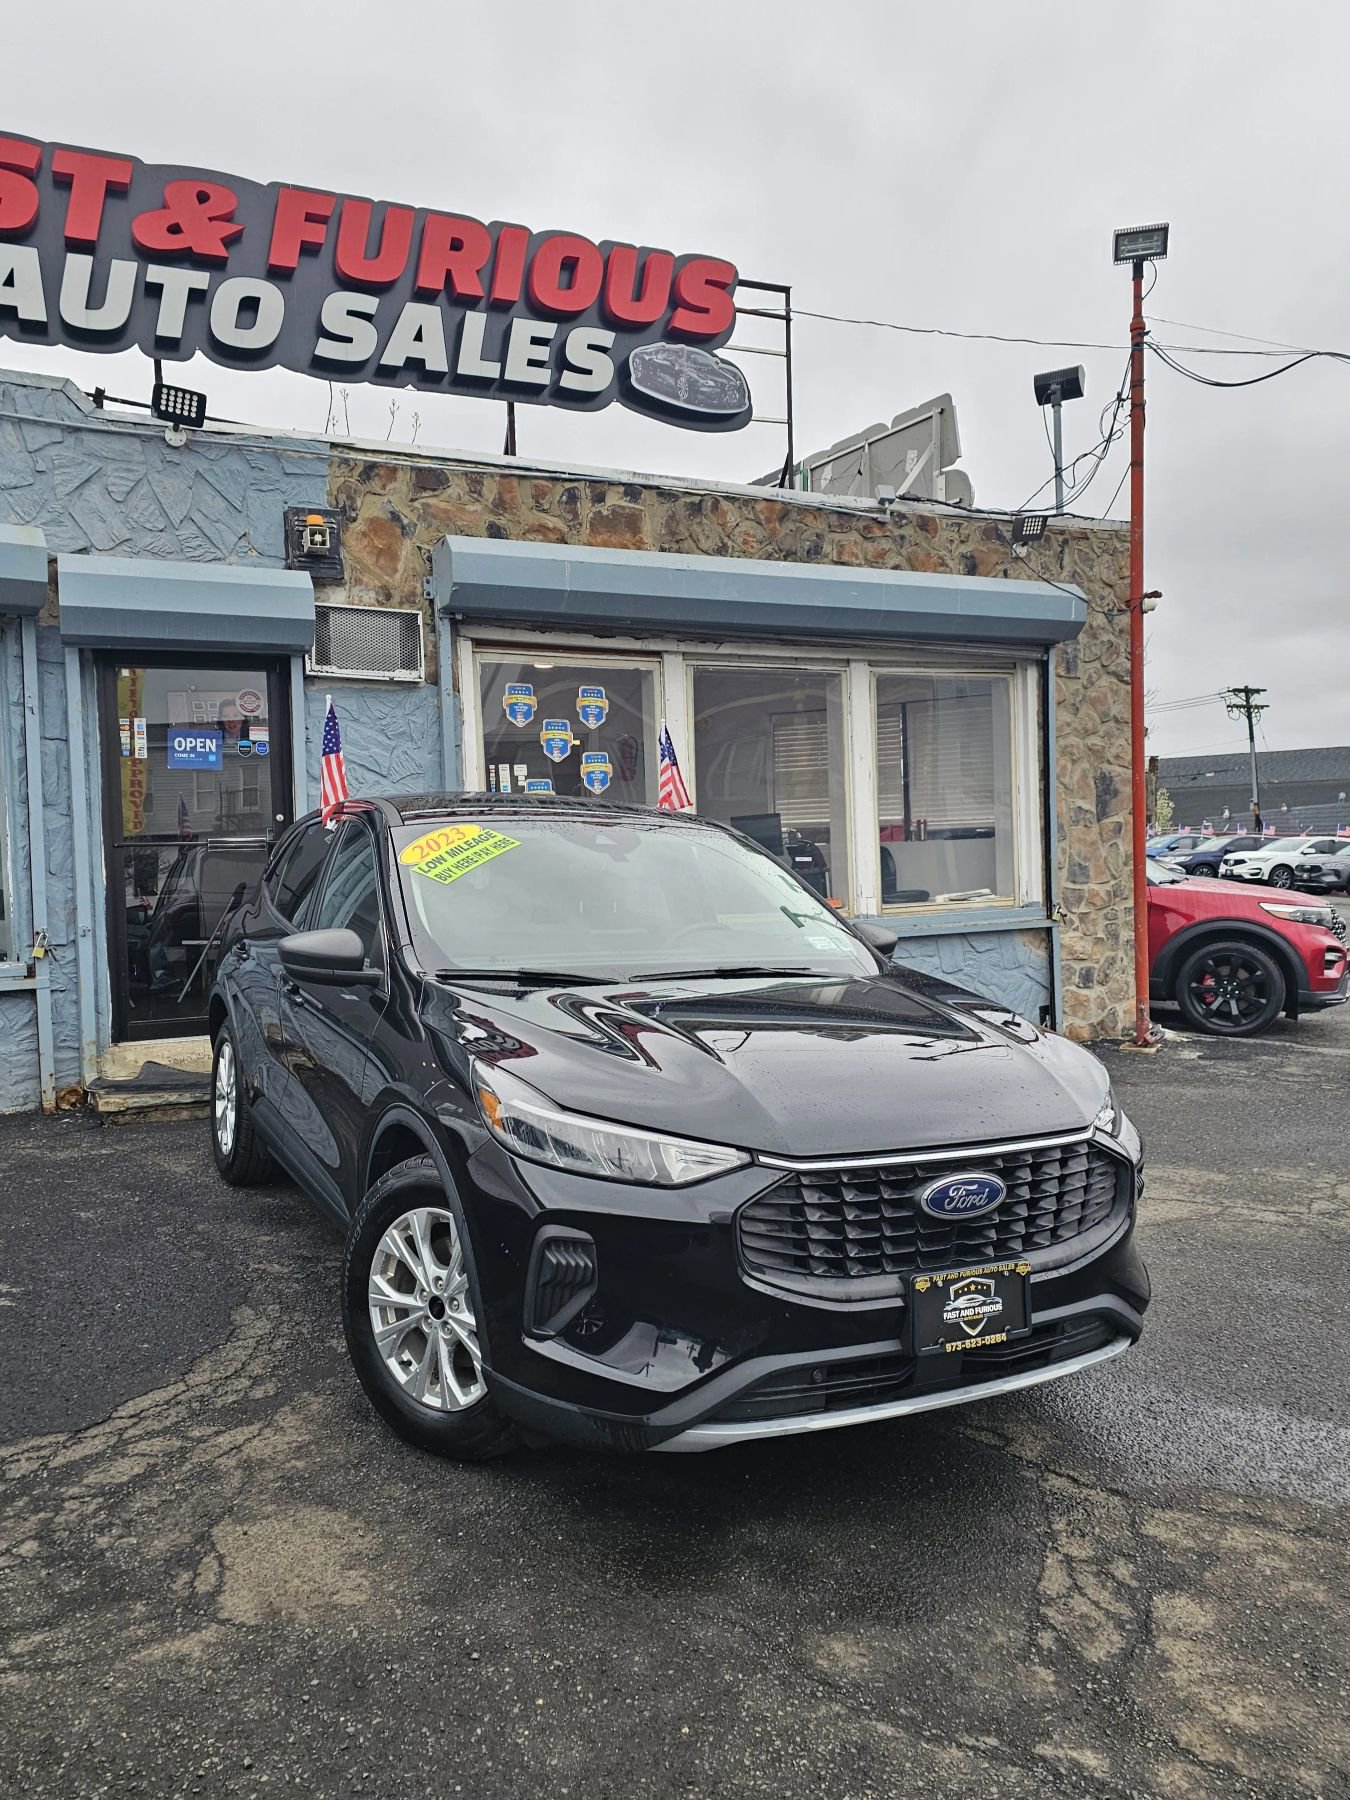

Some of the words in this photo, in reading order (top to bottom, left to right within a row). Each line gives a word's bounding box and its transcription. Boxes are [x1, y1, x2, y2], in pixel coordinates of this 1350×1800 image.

[131, 179, 246, 263] &
[267, 187, 737, 335] FURIOUS
[0, 242, 286, 350] AUTO
[313, 290, 617, 392] SALES
[174, 737, 217, 753] OPEN
[129, 755, 144, 831] PPROVED
[413, 827, 466, 860] 2023
[418, 854, 448, 874] LOW
[445, 830, 497, 858] MILEAGE
[434, 867, 458, 882] BUY
[489, 837, 516, 851] HERE
[944, 1183, 989, 1210] Ford
[933, 1274, 947, 1282] FAST
[946, 1272, 959, 1280] AND
[960, 1268, 983, 1278] FURIOUS
[983, 1266, 998, 1274] AUTO
[998, 1263, 1015, 1271] SALES
[943, 1310, 960, 1320] FAST
[960, 1308, 975, 1317] AND
[975, 1303, 1003, 1315] FURIOUS
[945, 1333, 1007, 1352] 973-623-0284
